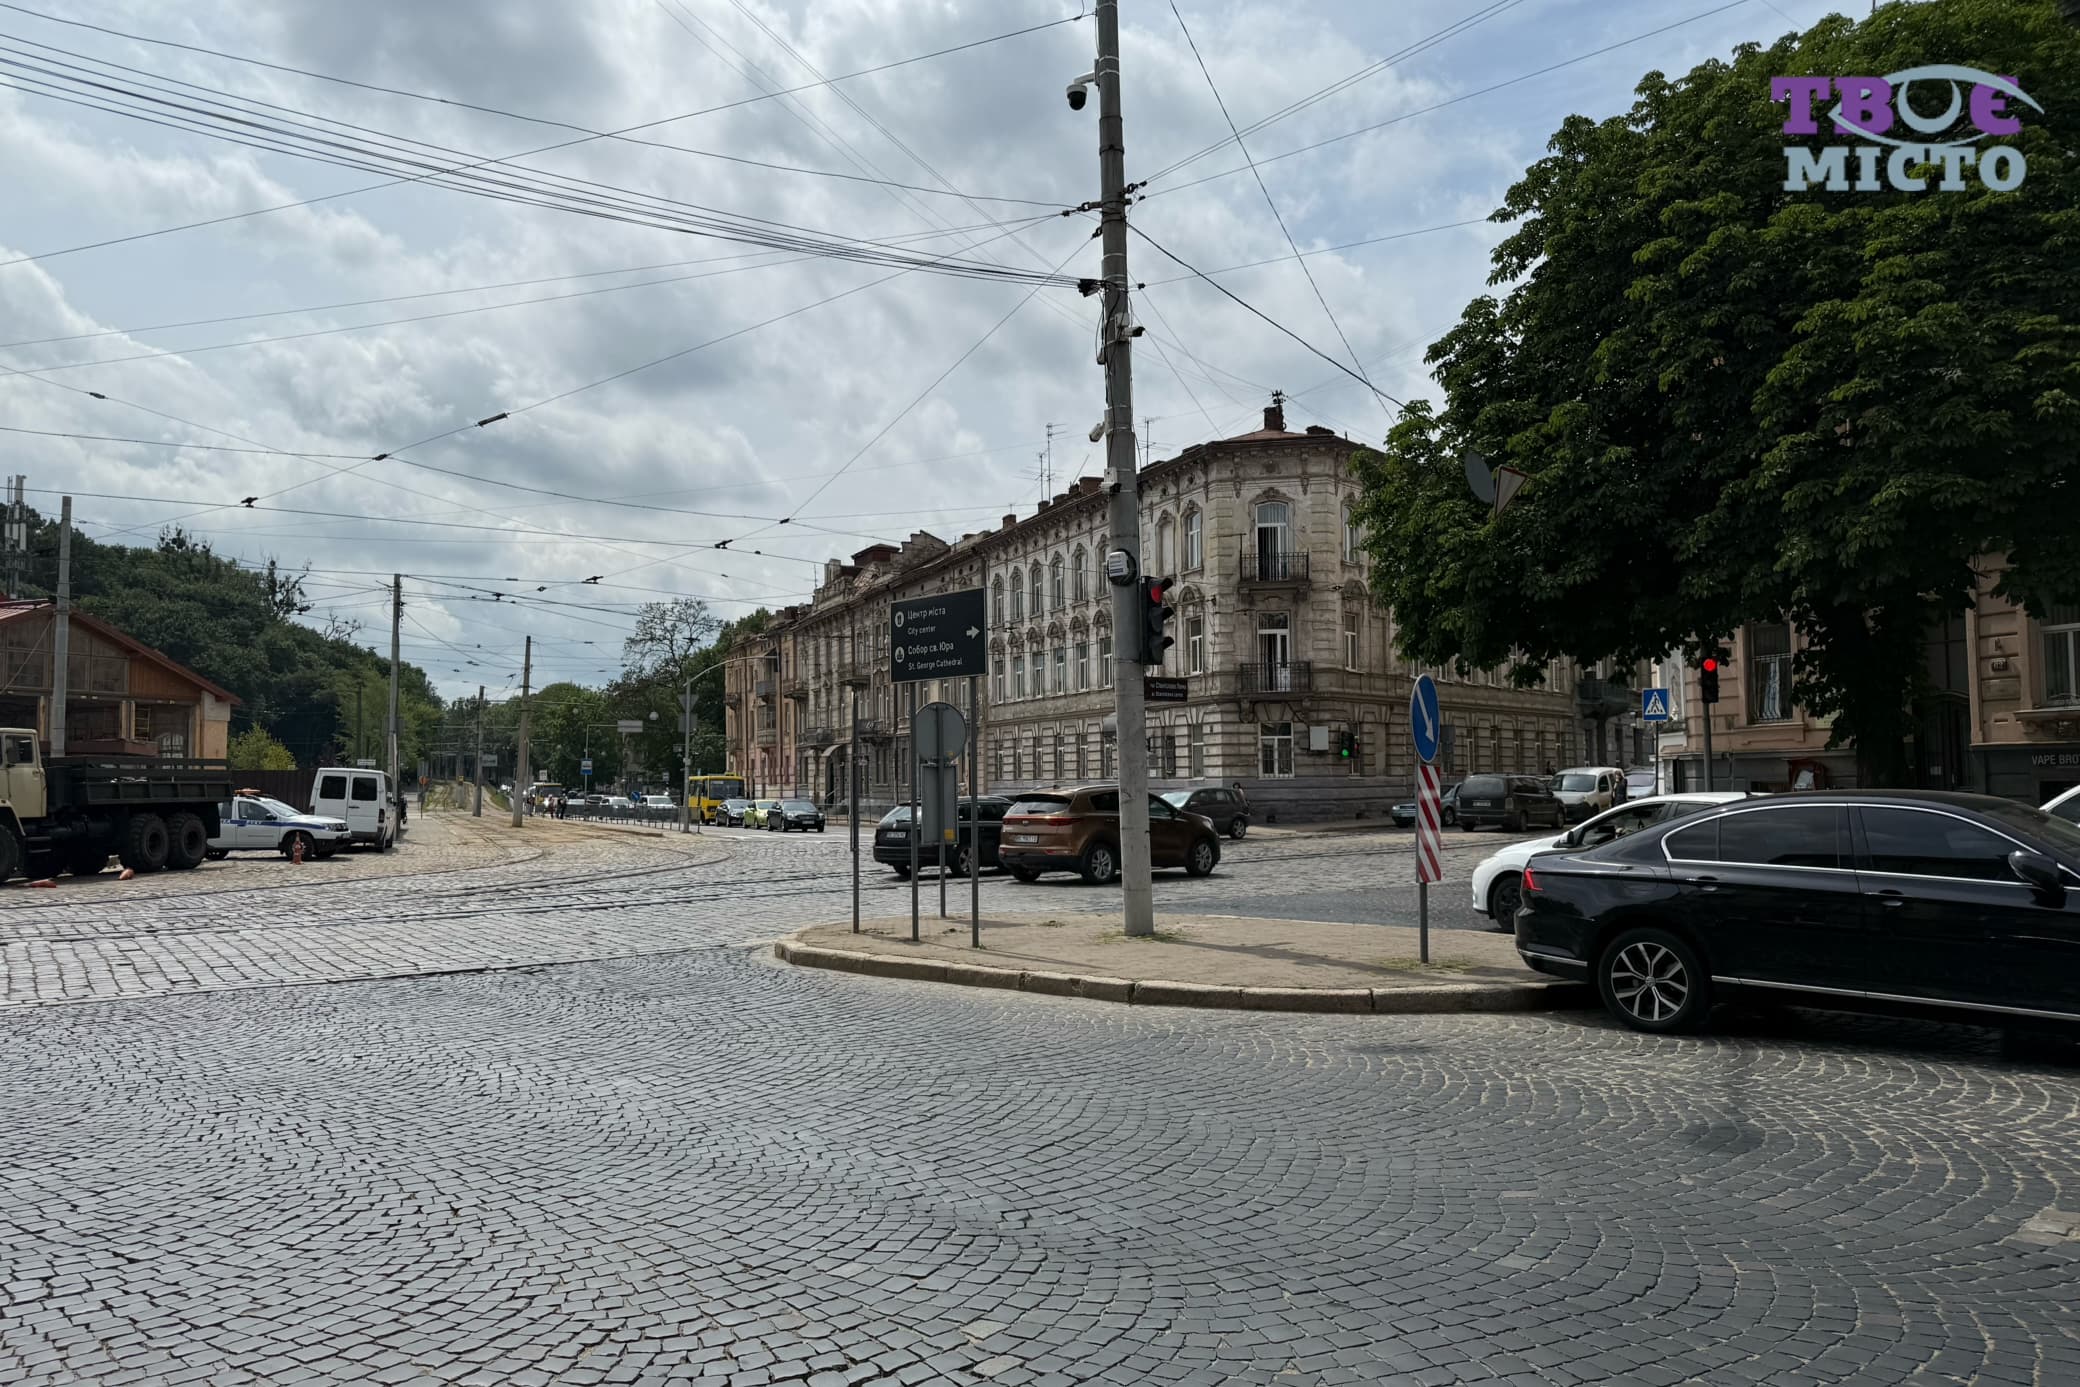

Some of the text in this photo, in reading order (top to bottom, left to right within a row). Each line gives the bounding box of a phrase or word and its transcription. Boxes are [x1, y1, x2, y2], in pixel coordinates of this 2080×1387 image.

[907, 607, 946, 620] Центр міста
[907, 625, 936, 636] City center
[908, 641, 954, 655] Собор св. Юра
[917, 661, 935, 671] George
[936, 657, 962, 667] Cathedral
[2032, 754, 2080, 766] VAPE BRO
